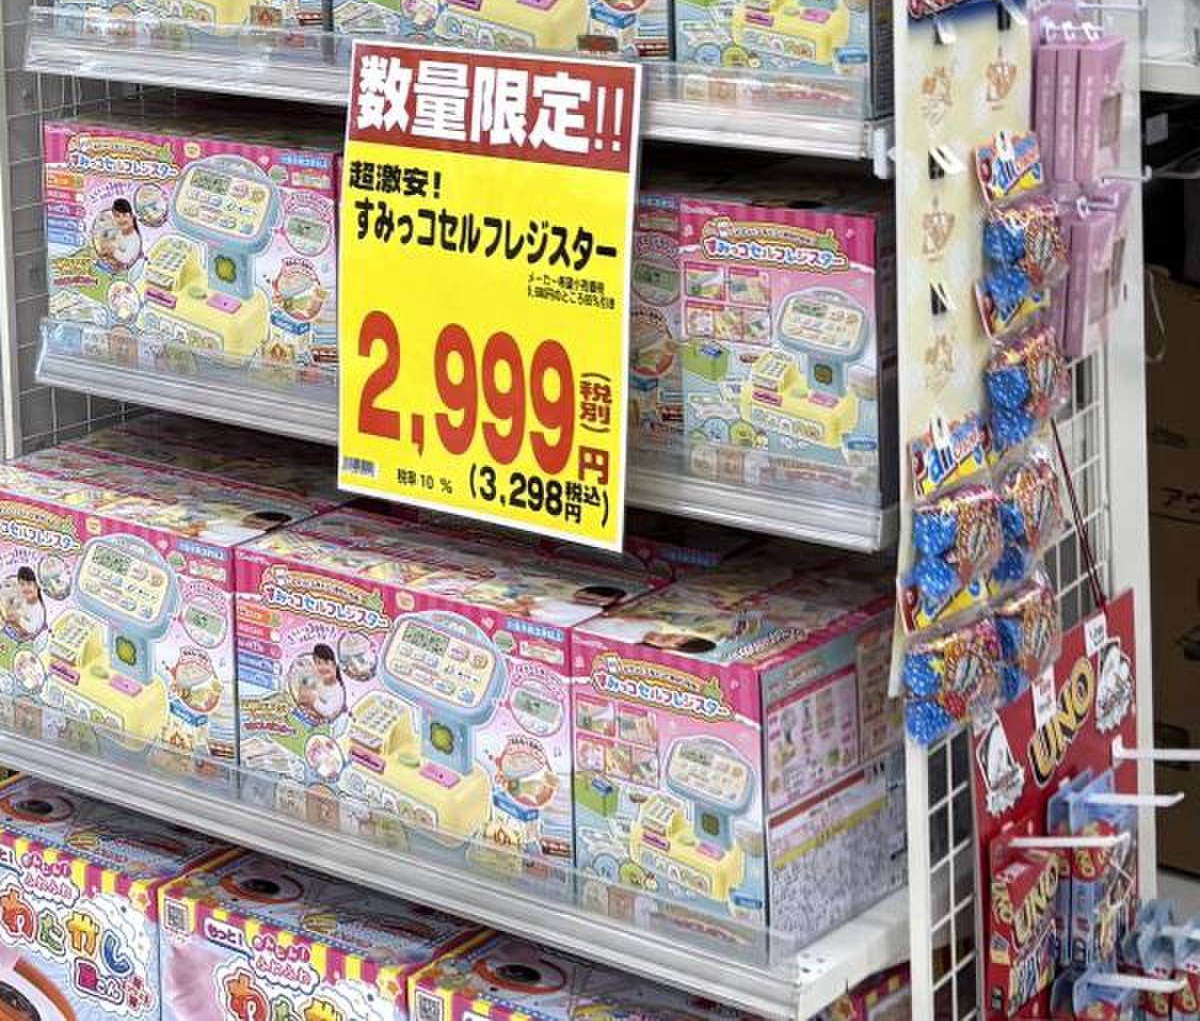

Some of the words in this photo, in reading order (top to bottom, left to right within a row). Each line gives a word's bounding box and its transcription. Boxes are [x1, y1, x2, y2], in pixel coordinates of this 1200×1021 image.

[356, 55, 624, 153] 数量限定!!
[349, 160, 442, 199] 超激安!
[354, 197, 617, 271] すみっコセルフレジスター
[358, 310, 575, 476] 2,999
[1028, 656, 1096, 786] UNO
